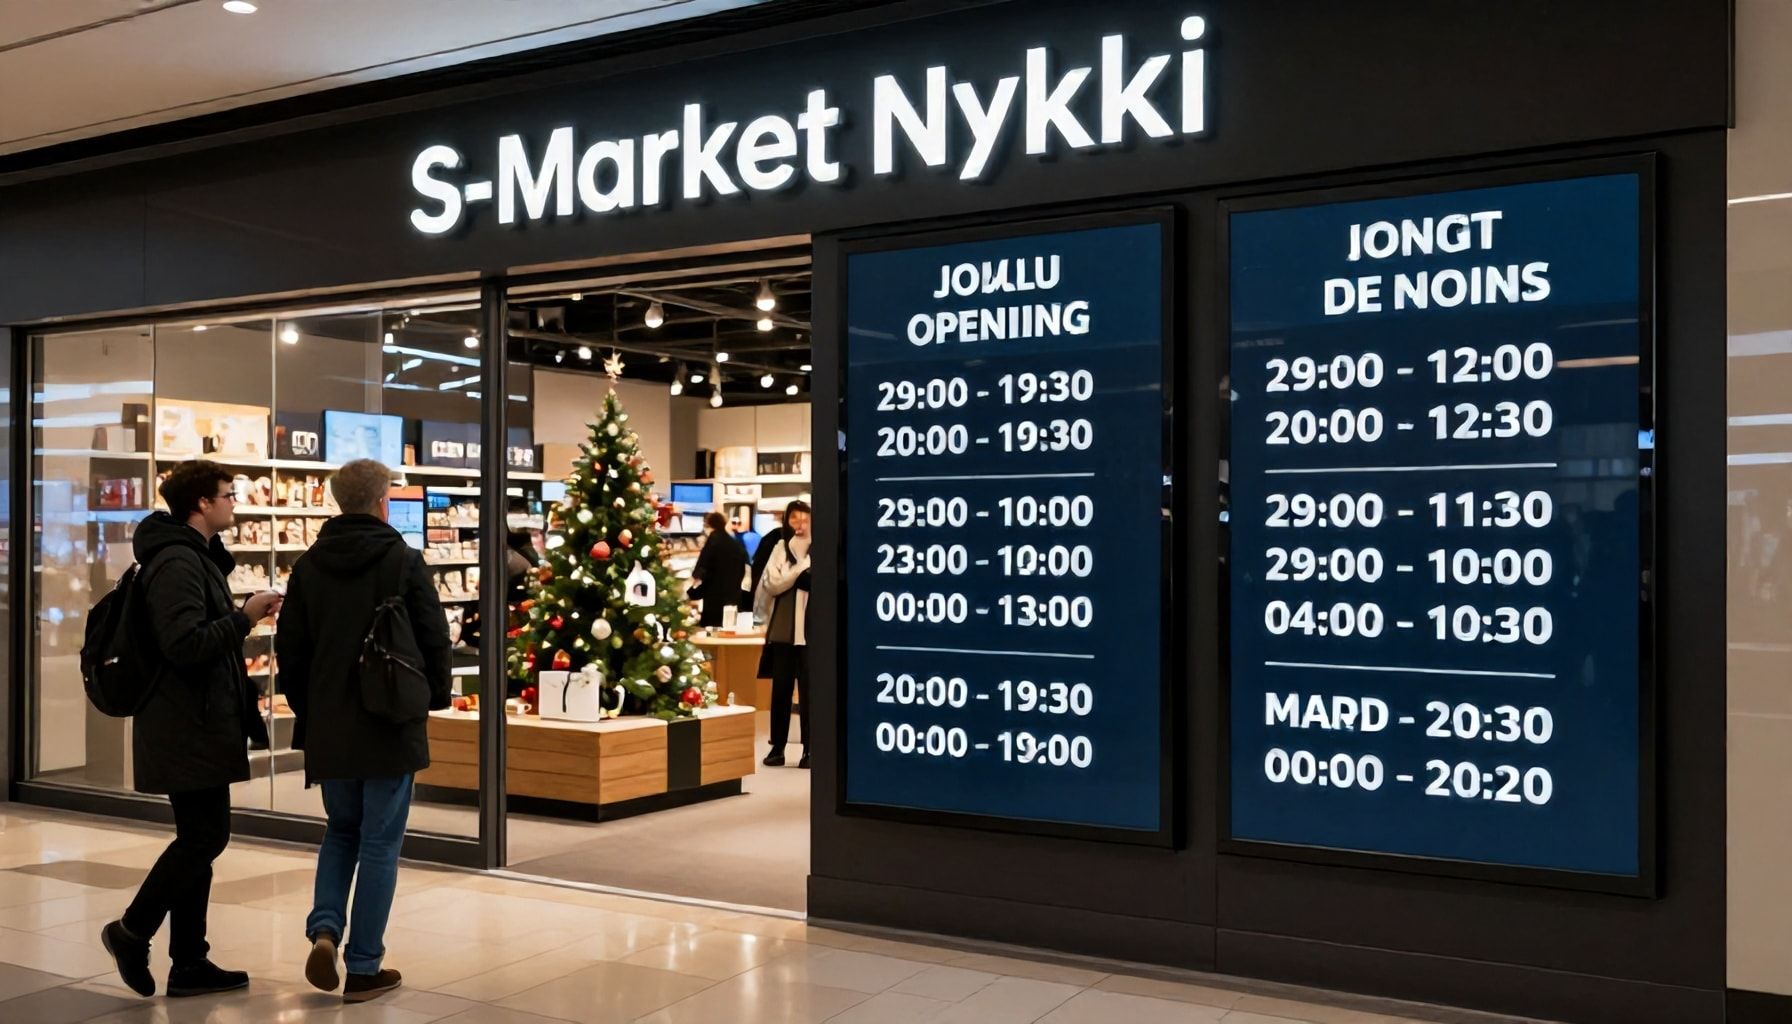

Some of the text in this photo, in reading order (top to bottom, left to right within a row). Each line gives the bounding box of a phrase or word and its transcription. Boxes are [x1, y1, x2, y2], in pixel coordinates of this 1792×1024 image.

[410, 15, 1205, 235] S-Market Nykki
[1347, 210, 1503, 262] JONGT
[1324, 261, 1551, 316] DE NOINS
[1265, 352, 1384, 393] 29:00
[1427, 342, 1554, 384] 12:00
[876, 376, 968, 411] 29:00
[998, 369, 1094, 404] 19:30
[876, 424, 968, 457] 20:00
[998, 418, 1093, 452] 19:30
[1265, 407, 1384, 445] 20:00
[1428, 399, 1553, 440] 12:30
[877, 496, 968, 528] 29:00
[998, 494, 1094, 527] 10:00
[1265, 492, 1384, 528] 29:00
[1428, 490, 1553, 528] 11:30
[876, 543, 968, 575] 23:00
[1265, 546, 1384, 583] 29:00
[1428, 548, 1553, 586] 10:00
[876, 591, 968, 624] 00:00
[1264, 600, 1384, 638] 04:00
[1427, 604, 1553, 645] 10:30
[876, 672, 968, 708] 20:00
[998, 680, 1093, 716] 19:30
[876, 722, 968, 758] 00:00
[1425, 700, 1554, 744] 20:30
[1264, 747, 1384, 791] 00:00
[1425, 759, 1553, 805] 20:20
